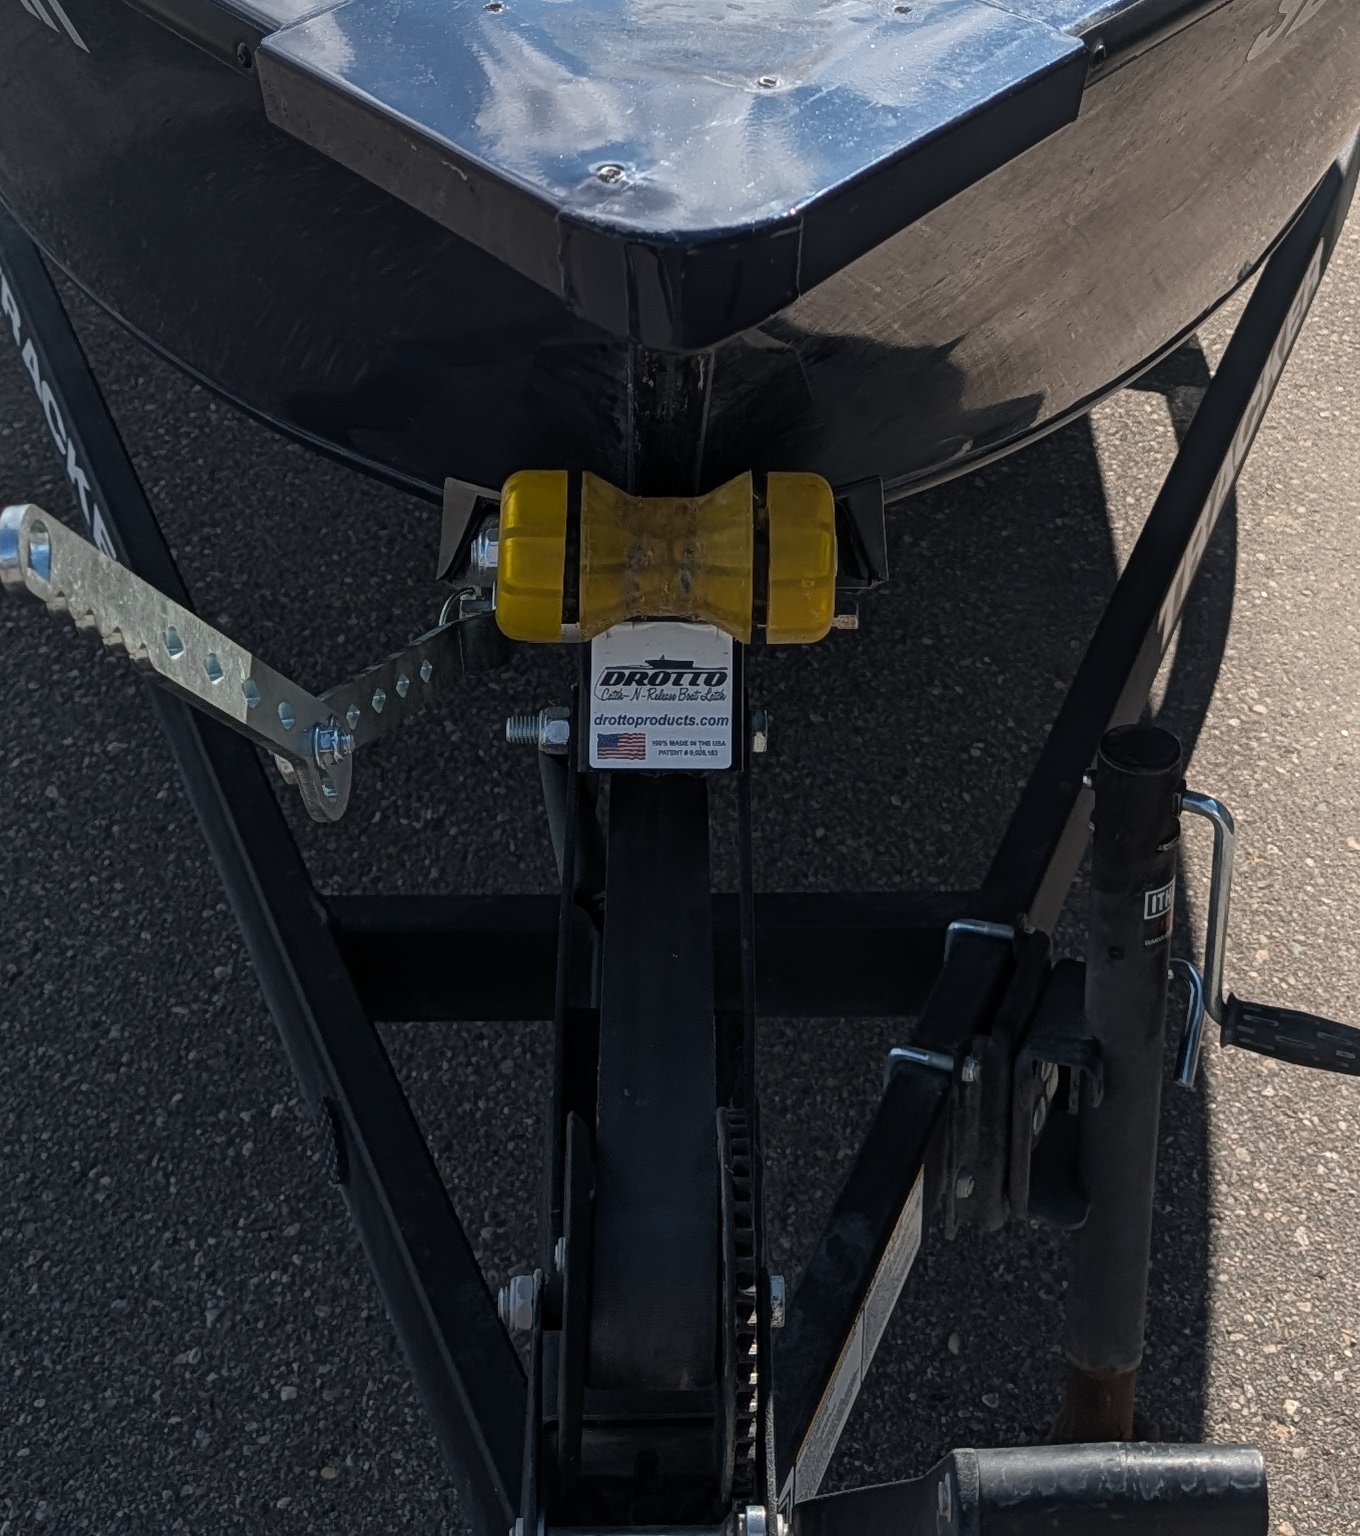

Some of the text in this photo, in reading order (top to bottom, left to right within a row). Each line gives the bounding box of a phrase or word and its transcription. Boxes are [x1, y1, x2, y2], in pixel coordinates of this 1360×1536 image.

[1156, 235, 1326, 656] TRACKER
[599, 670, 728, 687] DROTTO
[678, 687, 701, 702] Boat
[700, 687, 728, 702] Latch
[593, 713, 730, 729] drottoproducts.com
